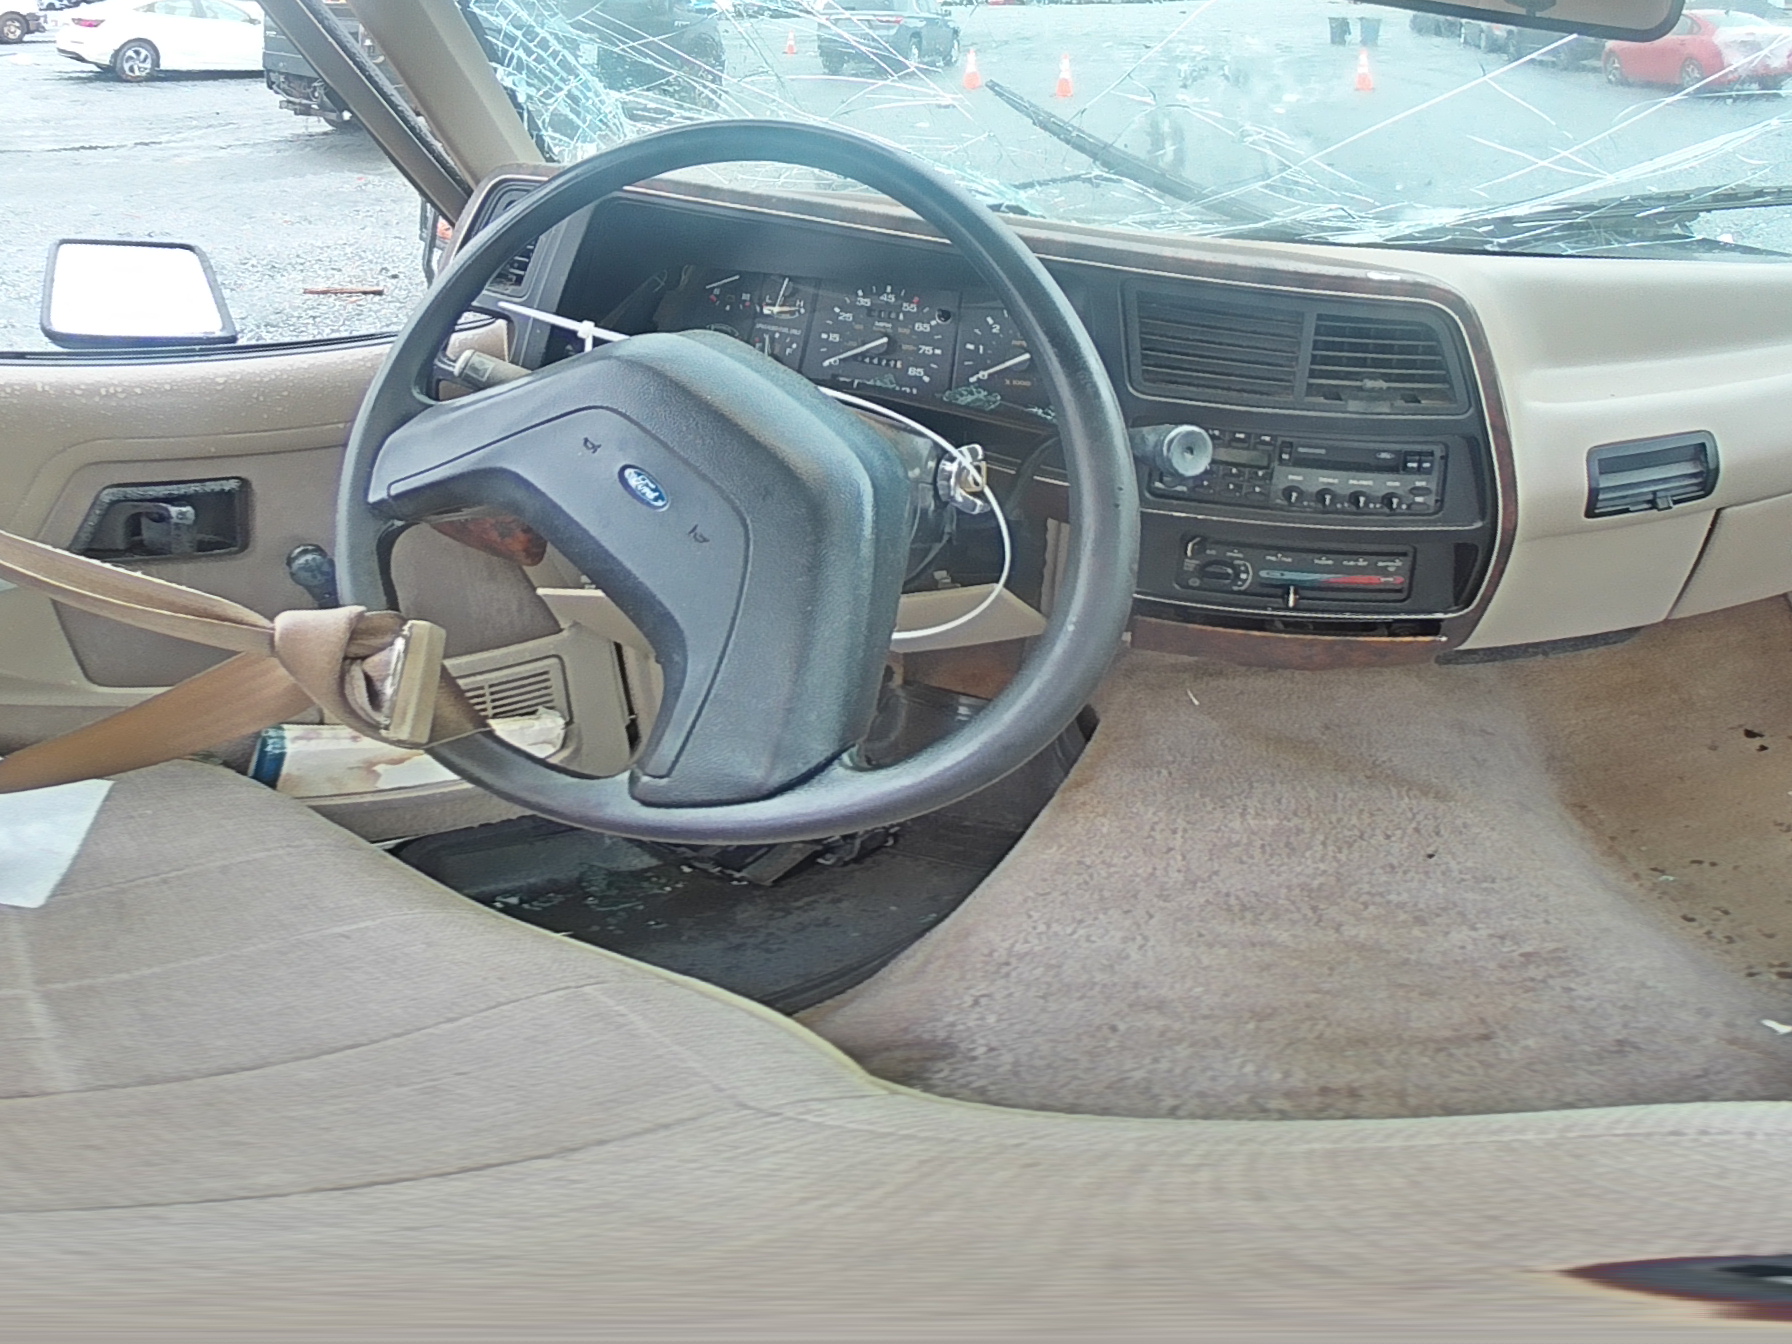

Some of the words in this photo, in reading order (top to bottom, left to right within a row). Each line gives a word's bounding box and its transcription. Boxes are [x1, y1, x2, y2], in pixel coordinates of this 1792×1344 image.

[856, 297, 871, 307] 35
[879, 294, 896, 303] 45
[902, 303, 917, 312] 55
[838, 312, 853, 322] 25
[991, 324, 1001, 334] 2
[829, 333, 840, 342] 15
[918, 345, 934, 355] 75
[621, 466, 664, 505] Ford
